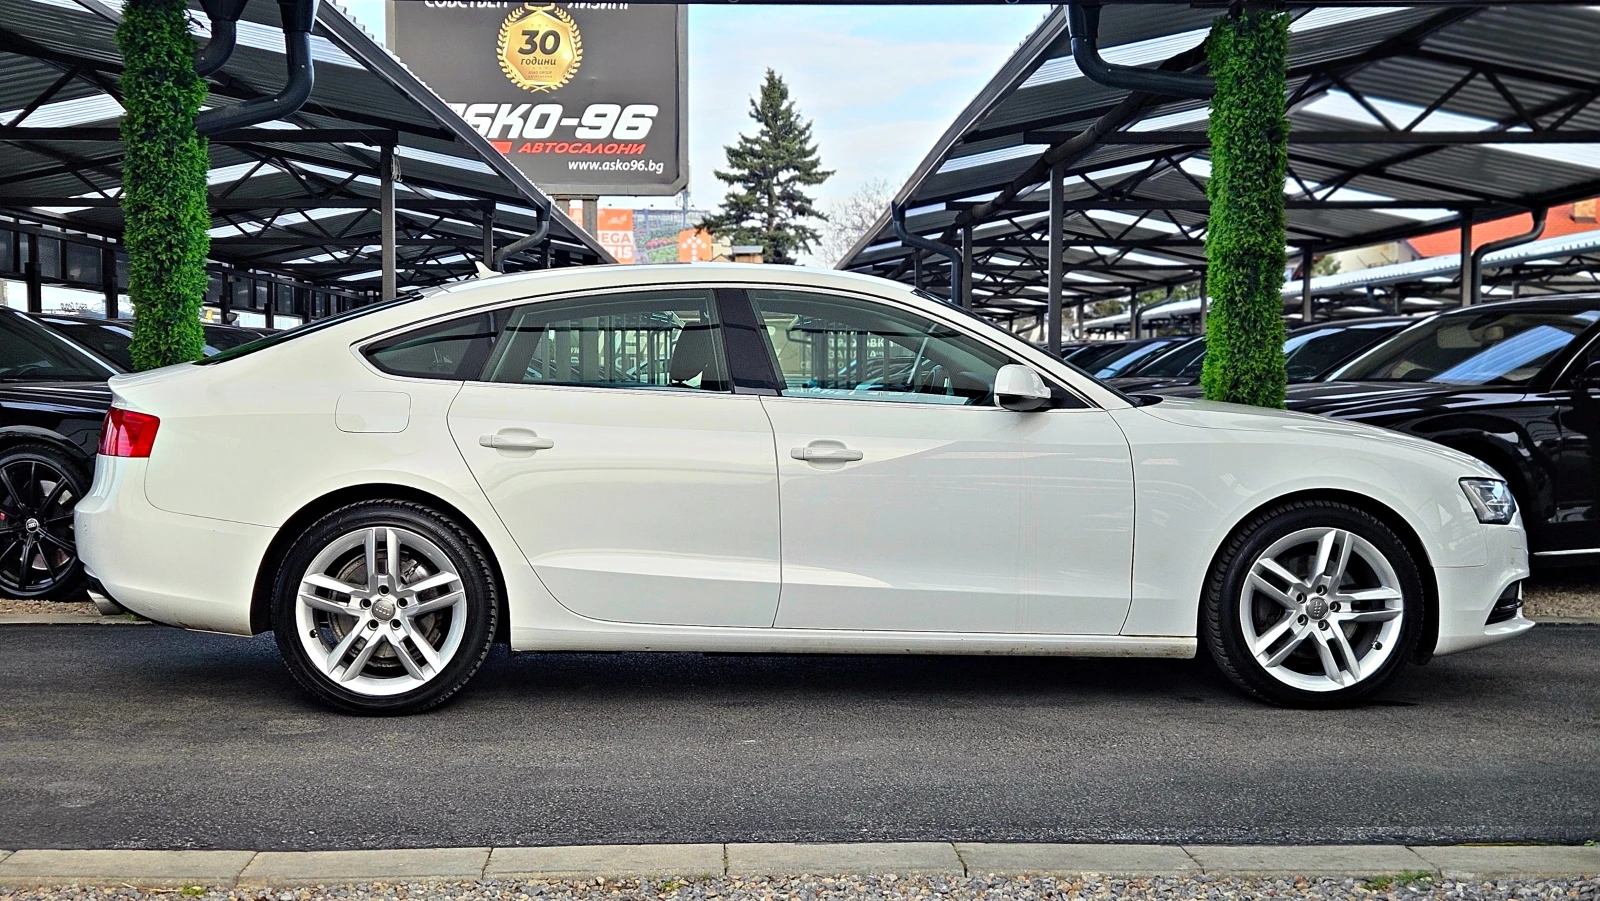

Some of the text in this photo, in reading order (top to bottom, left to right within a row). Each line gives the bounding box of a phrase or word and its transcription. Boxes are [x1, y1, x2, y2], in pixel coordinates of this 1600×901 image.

[517, 29, 561, 55] 30
[520, 57, 557, 67] години
[517, 142, 647, 155] АВТОСАЛОНИ
[568, 159, 664, 174] www.asko96.bg
[599, 232, 631, 244] EGA
